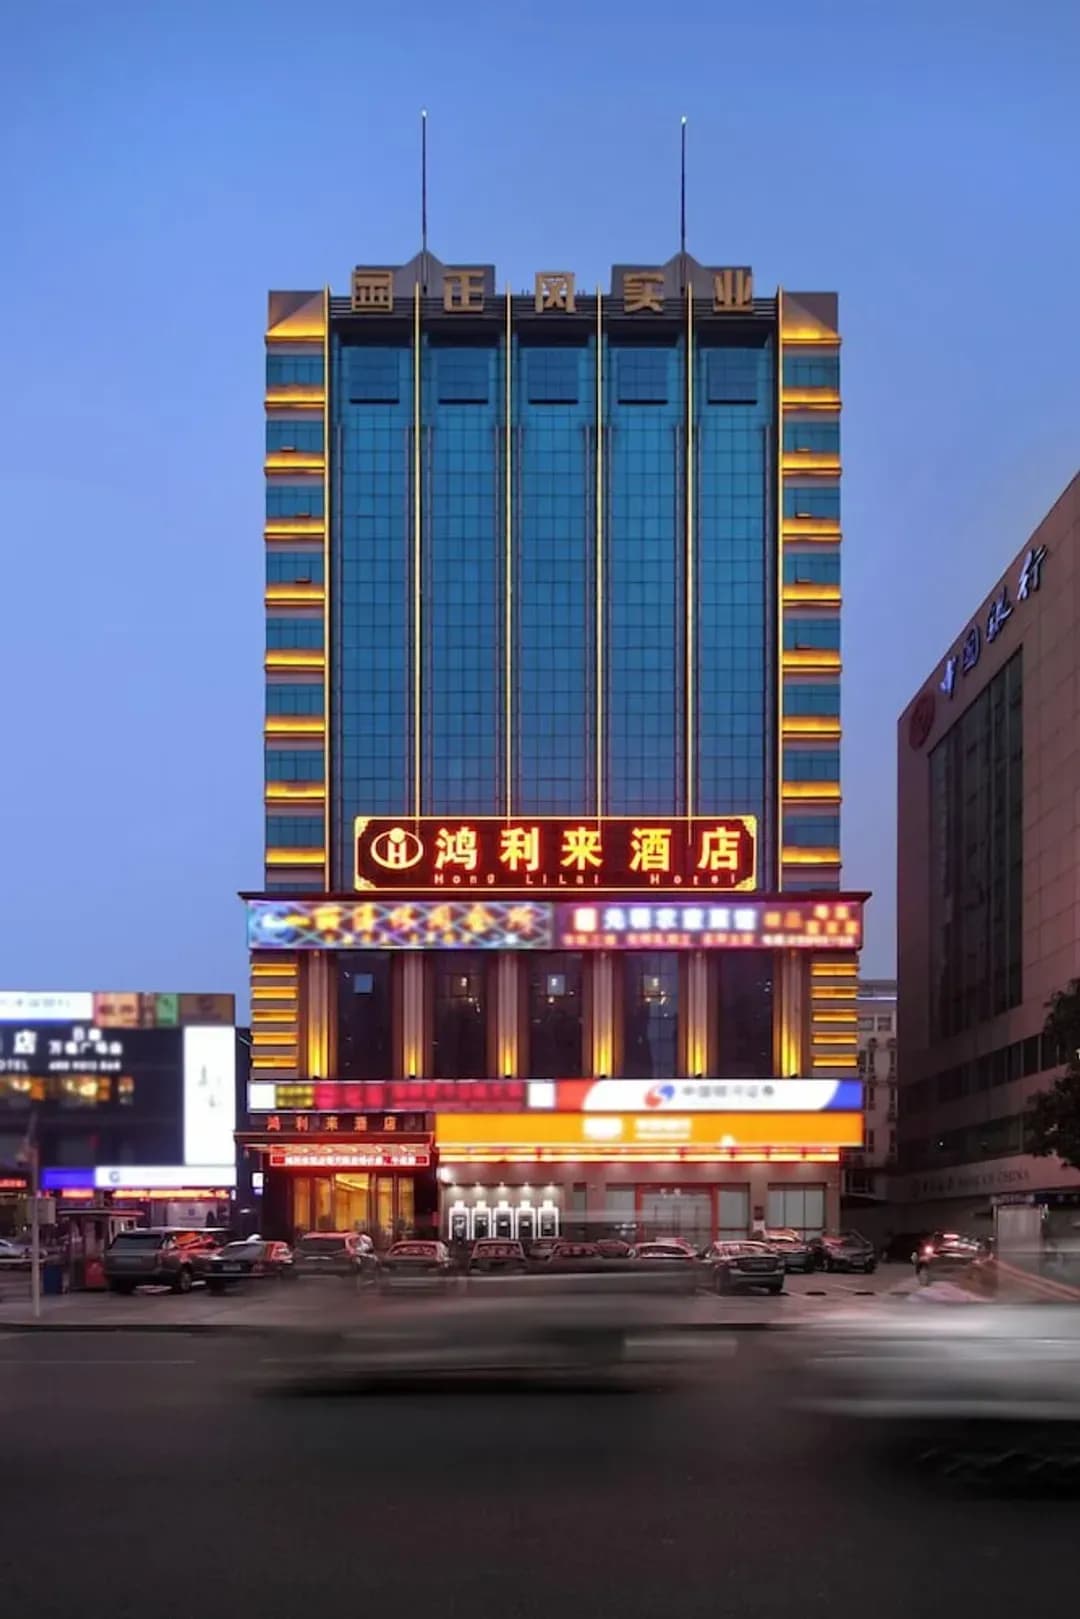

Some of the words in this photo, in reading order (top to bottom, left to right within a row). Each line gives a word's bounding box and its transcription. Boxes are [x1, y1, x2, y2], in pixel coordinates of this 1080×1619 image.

[433, 826, 741, 872] 鸿利来酒店
[433, 873, 496, 886] Hong
[649, 873, 736, 886] Hotel
